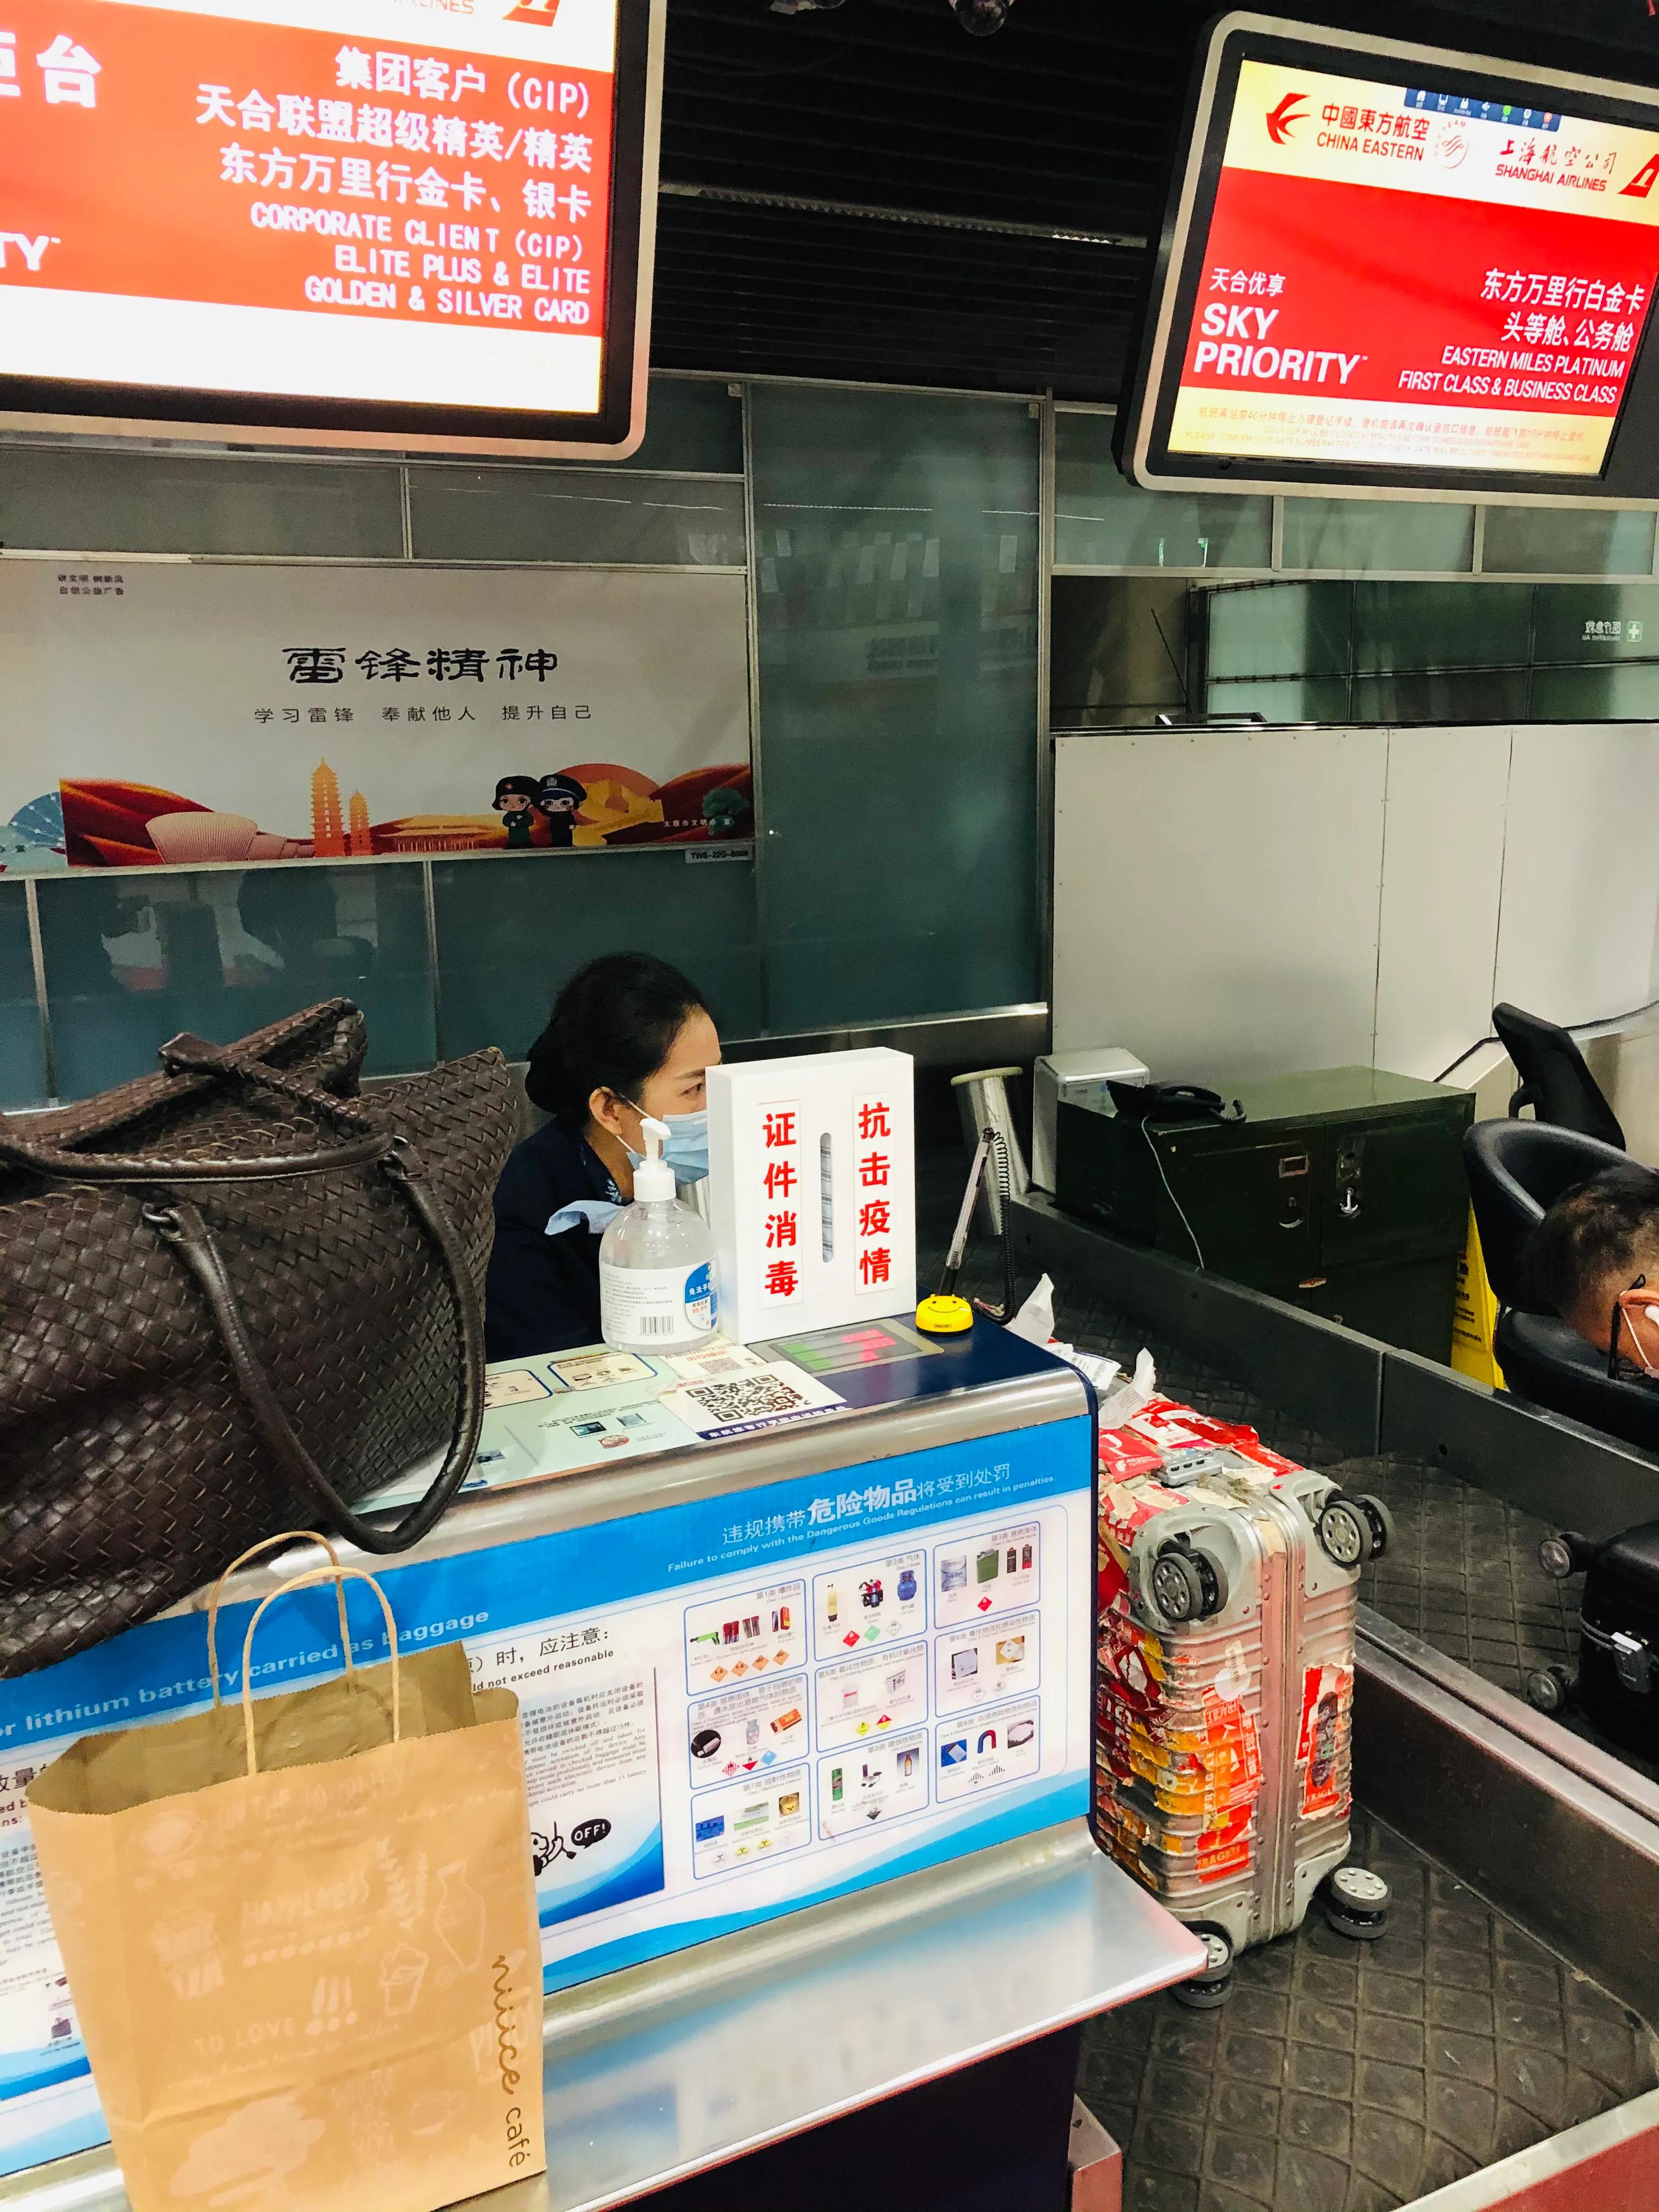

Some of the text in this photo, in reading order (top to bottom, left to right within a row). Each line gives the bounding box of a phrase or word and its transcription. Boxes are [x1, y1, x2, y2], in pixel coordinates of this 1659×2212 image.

[335, 45, 486, 103] 集团客户
[195, 84, 592, 173] 天合联盟超级精英/精英
[1321, 101, 1430, 143] 中國東方航空
[1317, 133, 1424, 161] CHINA EASTERN
[219, 143, 592, 222] 东方万里行金卡、银卡
[1495, 163, 1607, 192] SHANGHAI AIRLINES
[250, 201, 583, 261] CORPORATE CLIENT (CIP)
[335, 244, 590, 295] ELITE PLUS & ELITE
[1210, 267, 1286, 297] 天合优享
[305, 275, 589, 325] GOLDEN & SILVER CARD
[1480, 267, 1646, 315] 东方万里行白金卡
[1201, 303, 1279, 340] SKY
[1501, 311, 1634, 352] 头等舱、公务舱
[1193, 340, 1361, 385] PRIORITY
[1442, 346, 1625, 377] EASTERN MILES PLATINUM
[1398, 371, 1618, 404] FIRST CLASS & BUSINESS CLASS
[281, 647, 559, 684] 雷锋精神
[253, 704, 594, 724] 学习雷锋 奉献他人 提升自己
[761, 1111, 799, 1297] 证件消毒
[857, 1101, 891, 1285] 抗击疫情
[722, 1463, 1010, 1545] 违规携带危险物品将受到处罚
[668, 1557, 703, 1572] Failure
[707, 1554, 717, 1562] to
[720, 1544, 758, 1559] comply
[761, 1537, 785, 1550] with
[787, 1533, 804, 1543] the
[807, 1521, 860, 1539] Dangerous
[863, 1512, 894, 1525] Goods
[897, 1498, 953, 1517] Regulations
[955, 1493, 972, 1503] can
[974, 1487, 1000, 1499] result
[1002, 1484, 1011, 1492] in
[25, 1694, 130, 1733] lithium
[139, 1668, 239, 1705] battey
[249, 1644, 339, 1677] carried
[349, 1636, 375, 1656] as
[382, 1610, 489, 1648] baggage
[488, 1677, 507, 1688] not
[511, 1665, 550, 1683] exceed
[554, 1649, 614, 1672] reasonable
[617, 1731, 633, 1739] taken
[633, 1734, 646, 1742] Any
[541, 1794, 558, 1803] could
[574, 1822, 607, 1842] OFF!
[235, 2017, 294, 2047] LOVE
